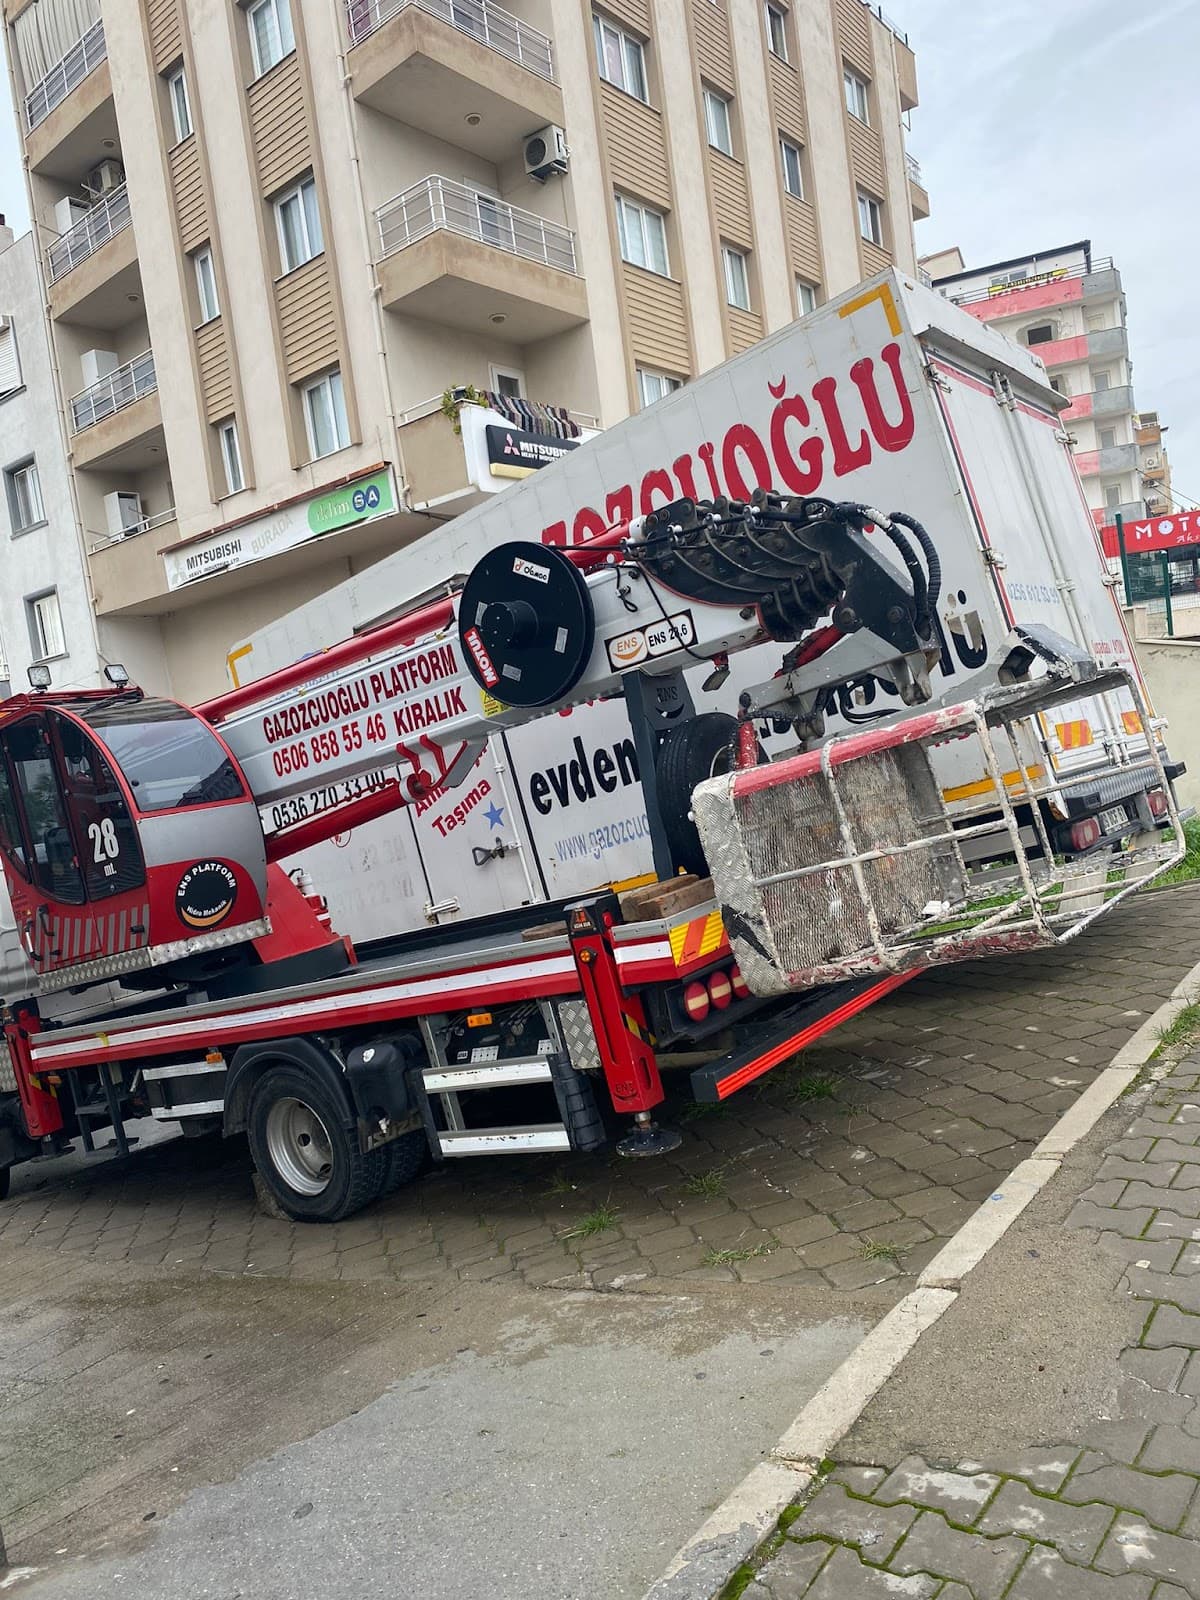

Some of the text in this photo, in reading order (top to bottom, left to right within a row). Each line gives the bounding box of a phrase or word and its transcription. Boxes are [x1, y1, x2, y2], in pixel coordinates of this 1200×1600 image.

[251, 513, 294, 554] BURADA
[1135, 515, 1200, 540] MOT
[186, 539, 242, 571] MITSUBISHI
[468, 631, 497, 683] MOTUL
[616, 636, 638, 653] ENS
[648, 631, 667, 648] ENS
[263, 679, 369, 744] GAZOZCUOĞLU
[370, 644, 458, 703] PLATFORM
[273, 741, 309, 777] 0506
[311, 730, 340, 764] 858
[341, 721, 363, 753] 55
[366, 713, 387, 744] 46
[393, 686, 468, 736] KİRALIK
[530, 735, 642, 816] evden
[272, 796, 308, 829] 0536
[310, 786, 338, 814] 270
[431, 779, 492, 837] Taşıma
[88, 817, 120, 863] 28
[177, 863, 237, 897] ENS PLATFORM
